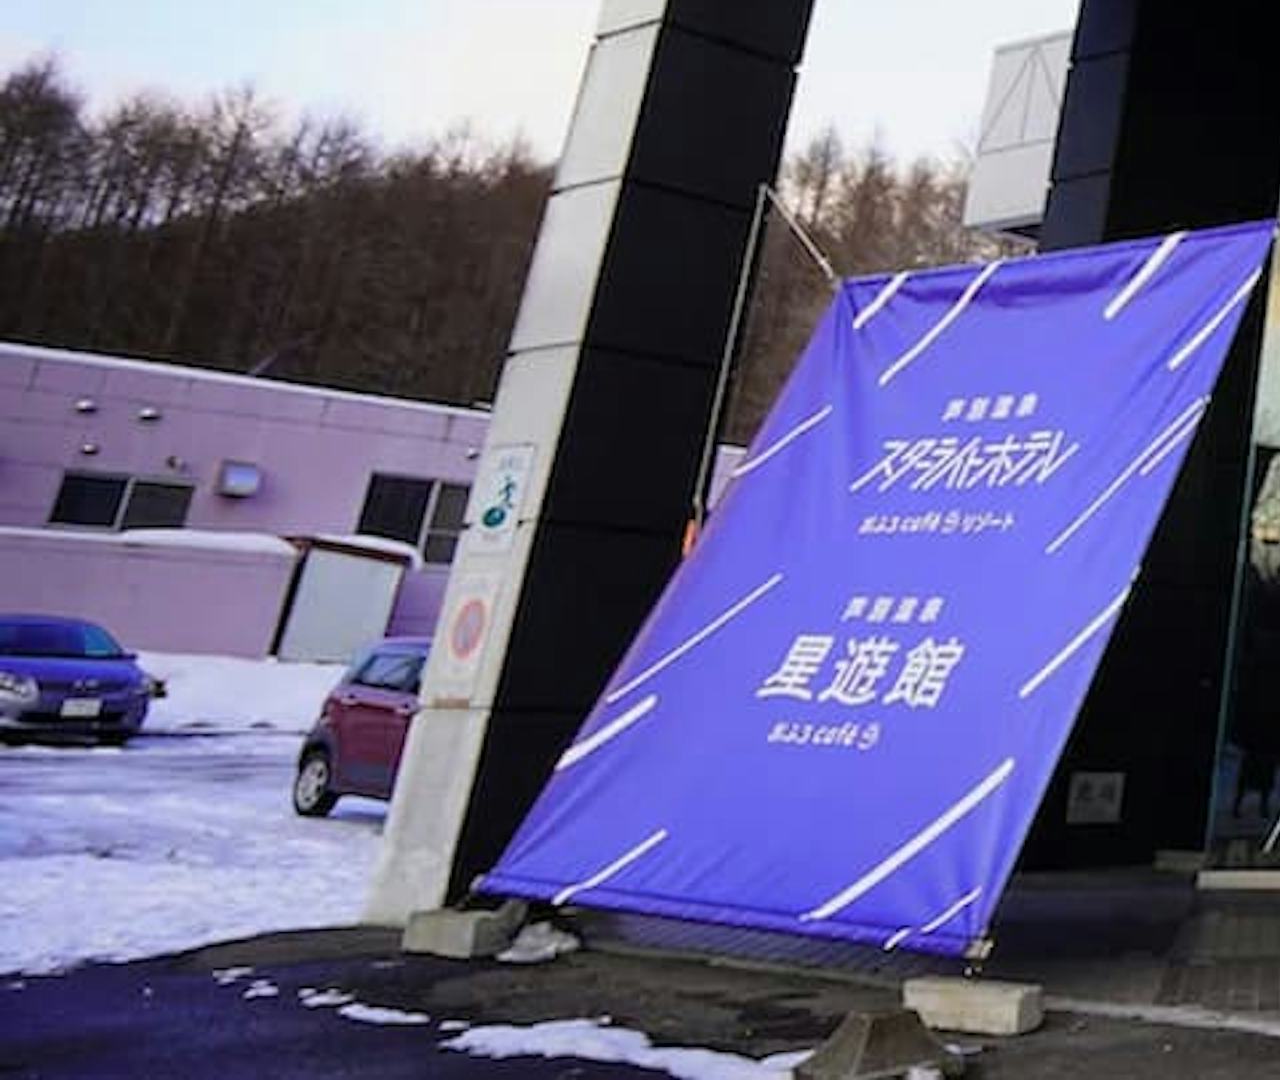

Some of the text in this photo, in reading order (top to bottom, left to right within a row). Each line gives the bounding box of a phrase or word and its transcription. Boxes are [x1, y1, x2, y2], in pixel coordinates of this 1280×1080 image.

[849, 429, 1080, 493] スターライトホテル
[755, 634, 966, 708] 星遊館
